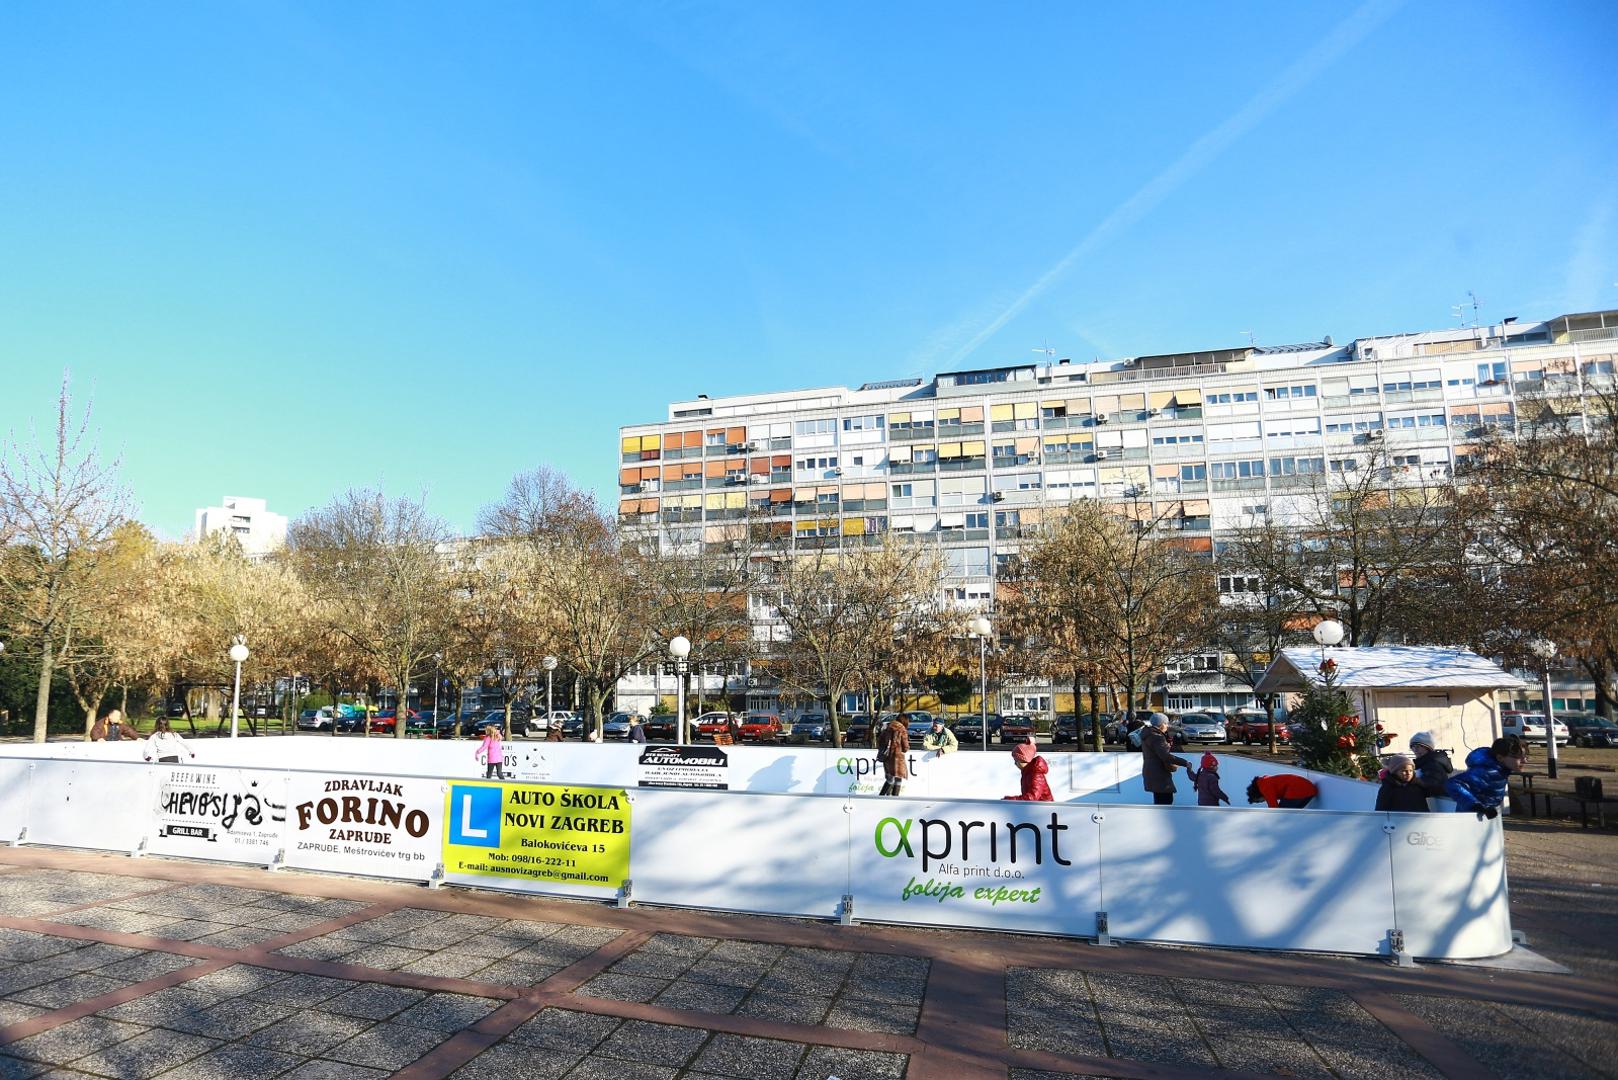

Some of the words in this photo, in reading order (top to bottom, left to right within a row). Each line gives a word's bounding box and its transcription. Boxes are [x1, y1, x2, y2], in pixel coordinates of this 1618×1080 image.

[481, 754, 517, 767] CO'S
[643, 756, 725, 766] AUTOMOBILI
[324, 779, 403, 797] ZDRAVLJAK
[509, 790, 555, 806] AUTO
[560, 788, 620, 810] ŠKOLA
[296, 796, 430, 838] FORINO
[504, 812, 545, 829] NOVI
[551, 815, 624, 834] ZAGREB
[172, 826, 189, 835] GRILL
[190, 828, 203, 837] BAR
[329, 828, 392, 845] ZAPRUĐE
[343, 845, 396, 859] Meštrovićev
[398, 851, 411, 861] trg
[413, 851, 425, 861] bb
[521, 838, 588, 852] Balokovićeva
[592, 844, 605, 853] 15
[488, 852, 509, 862] Mob:
[511, 855, 576, 867] 098/16-222-11
[458, 861, 488, 872] E-mail:
[490, 864, 609, 882] ausnovizagreb@gmail.com
[938, 863, 960, 876] Alfa
[963, 865, 991, 878] print
[994, 865, 1025, 879] d.o.o.
[902, 876, 965, 903] folija
[974, 885, 1041, 906] expert
